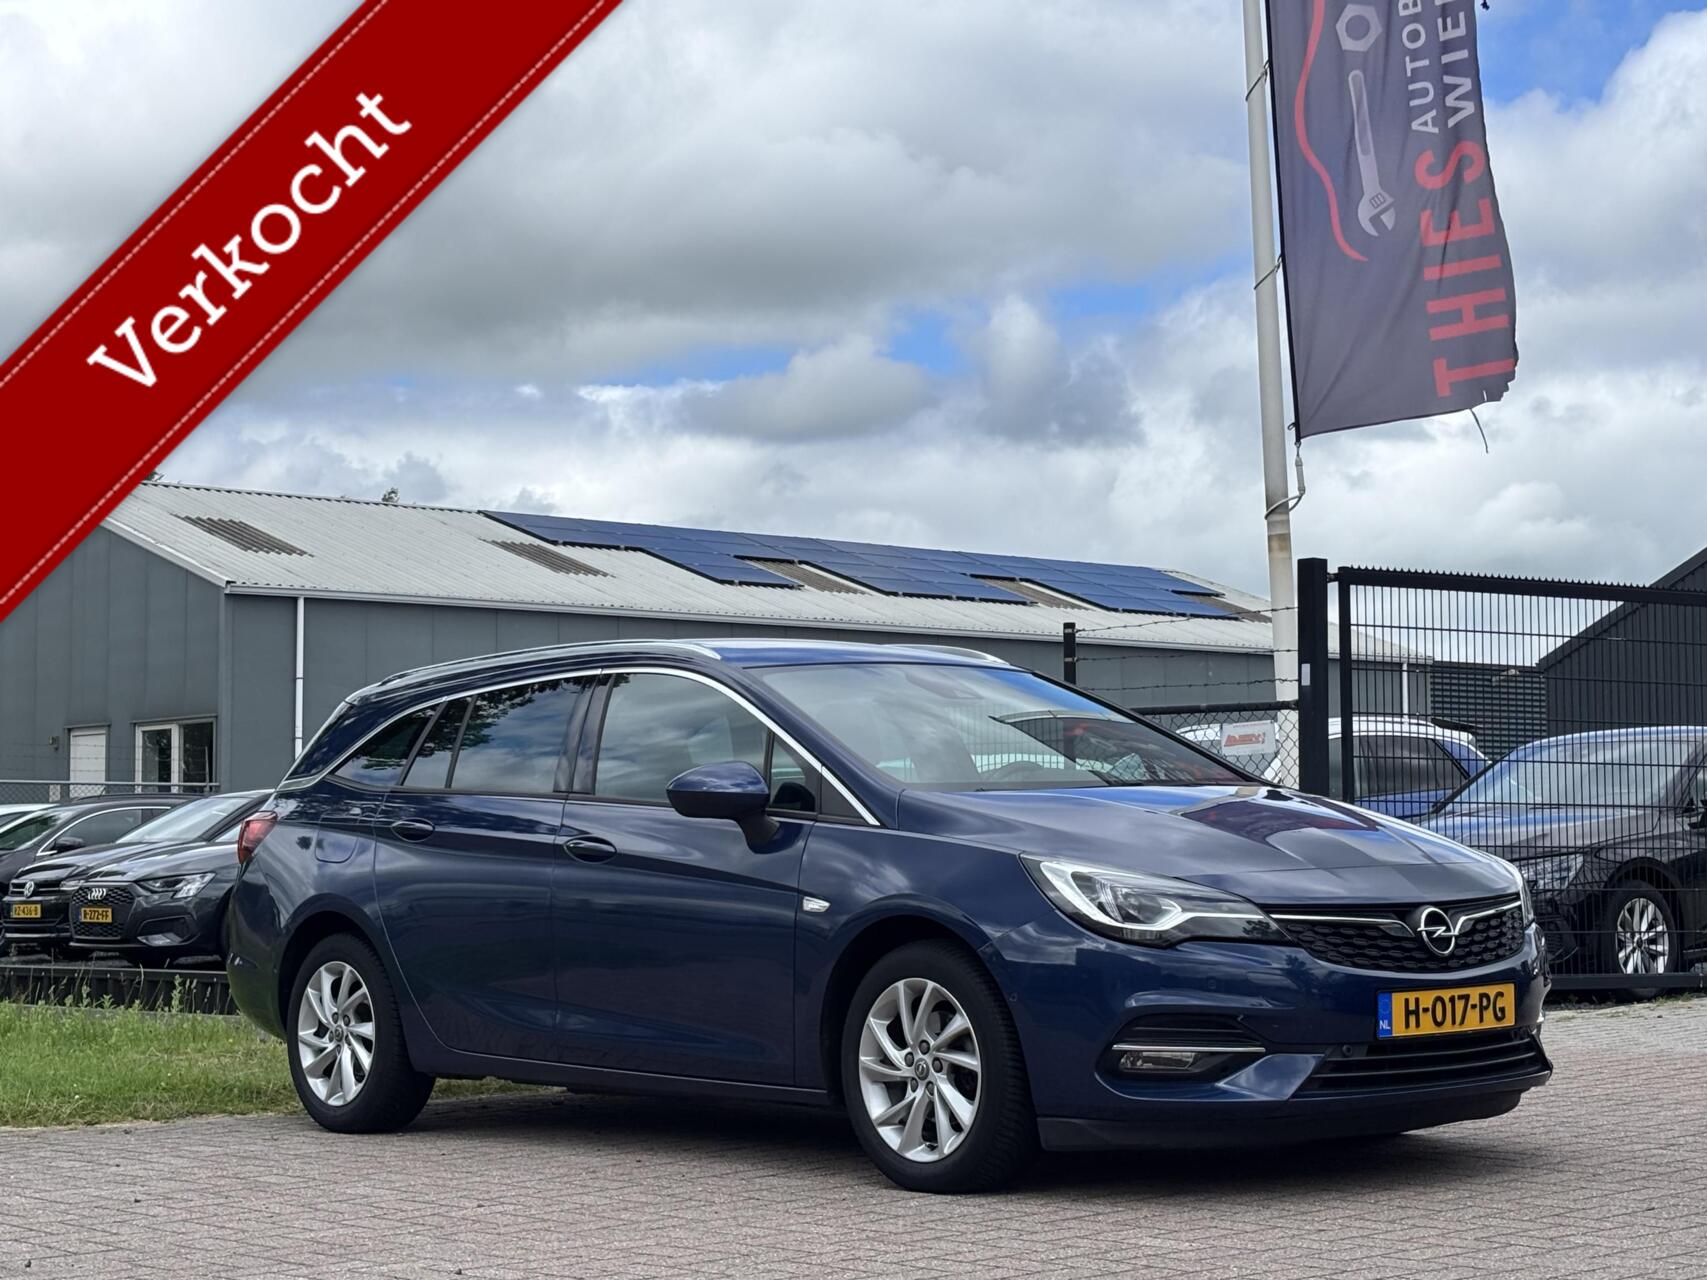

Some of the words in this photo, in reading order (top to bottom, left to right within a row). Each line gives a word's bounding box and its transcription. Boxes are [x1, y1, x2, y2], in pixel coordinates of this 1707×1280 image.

[1435, 0, 1476, 129] WIE
[1414, 139, 1516, 398] THIES
[1379, 1019, 1391, 1030] NL
[1404, 991, 1506, 1029] H-017-PG
